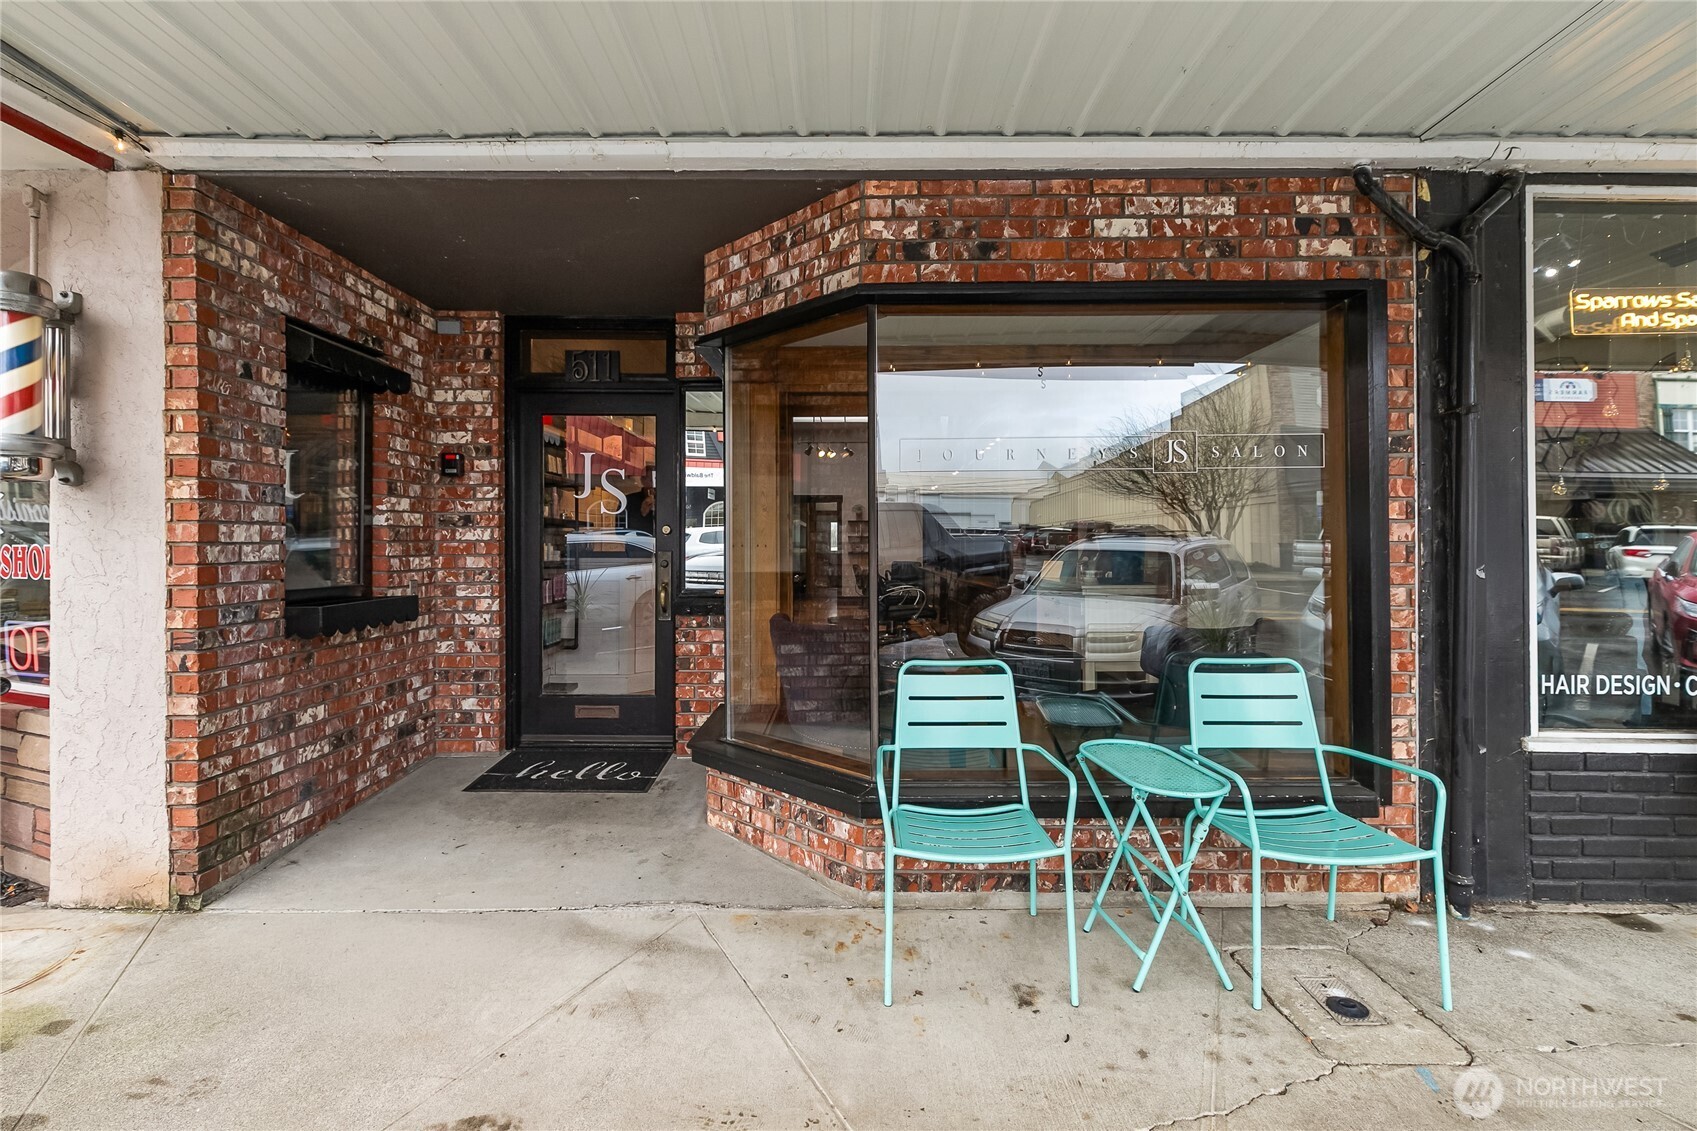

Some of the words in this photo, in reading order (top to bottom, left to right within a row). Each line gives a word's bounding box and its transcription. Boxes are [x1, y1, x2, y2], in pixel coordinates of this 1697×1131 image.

[1574, 293, 1673, 312] Sparrows
[1621, 311, 1659, 328] And
[571, 351, 614, 382] 511
[916, 446, 1138, 463] JOURNEYS
[1162, 439, 1187, 464] JS
[1211, 444, 1308, 459] SALON
[573, 452, 628, 515] JS
[1541, 674, 1590, 695] HAIR
[1596, 674, 1671, 695] DESIGN
[515, 760, 642, 781] hello
